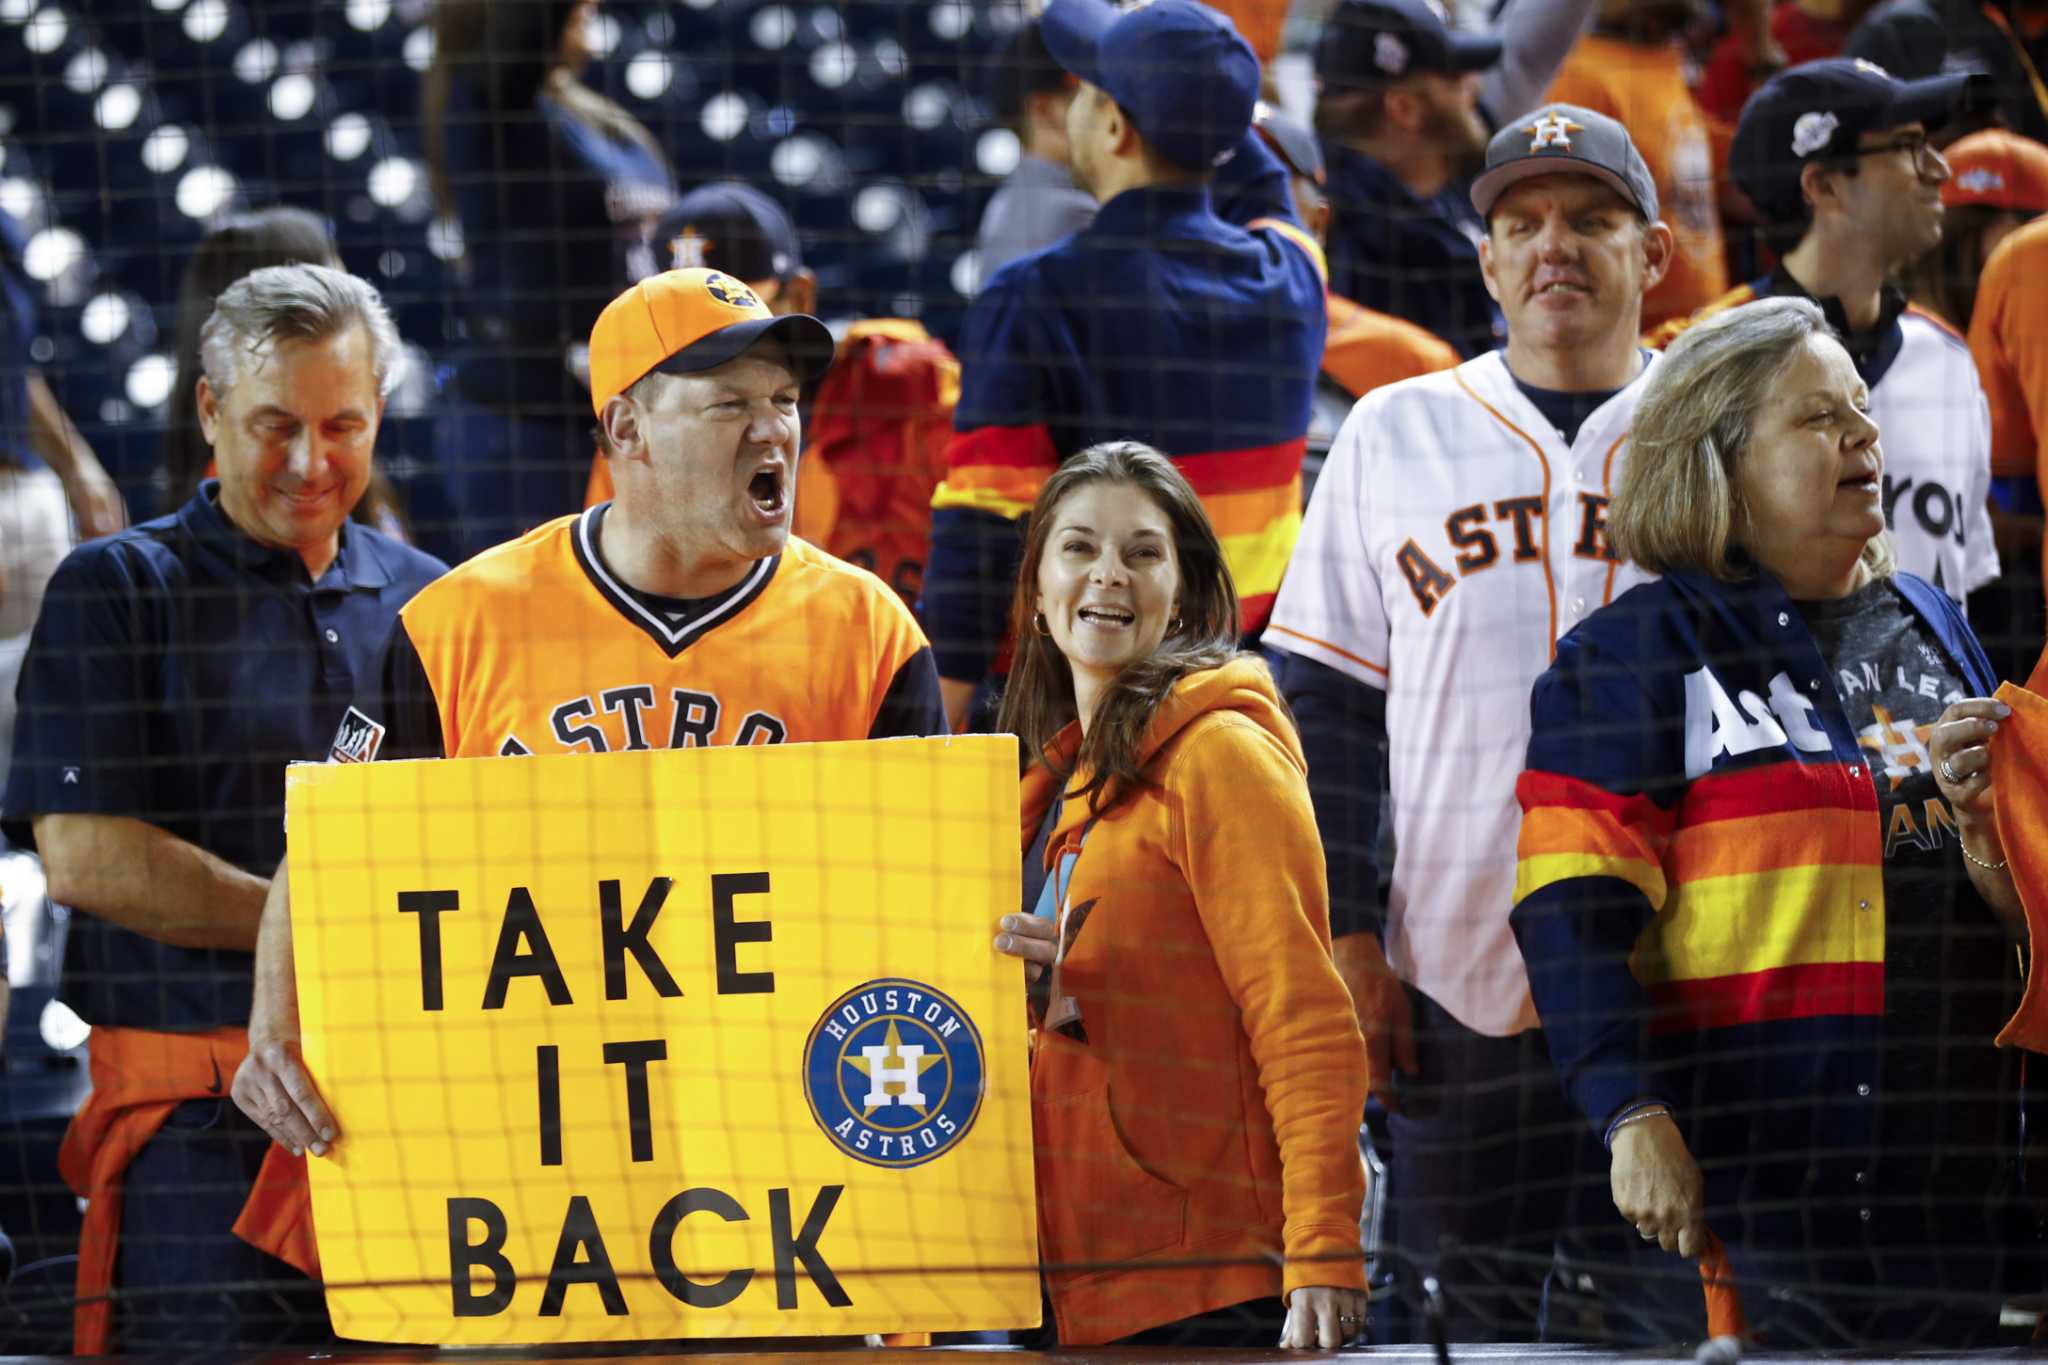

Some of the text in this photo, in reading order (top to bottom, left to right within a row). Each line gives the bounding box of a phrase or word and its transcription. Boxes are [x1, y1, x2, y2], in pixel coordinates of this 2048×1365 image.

[1881, 474, 1966, 547] ro
[398, 872, 774, 1010] TAKE
[825, 990, 961, 1041] HOUSTON
[538, 1040, 666, 1166] IT
[862, 1045, 926, 1106] H
[834, 1113, 956, 1157] ASTROS
[448, 1185, 853, 1317] BACK
